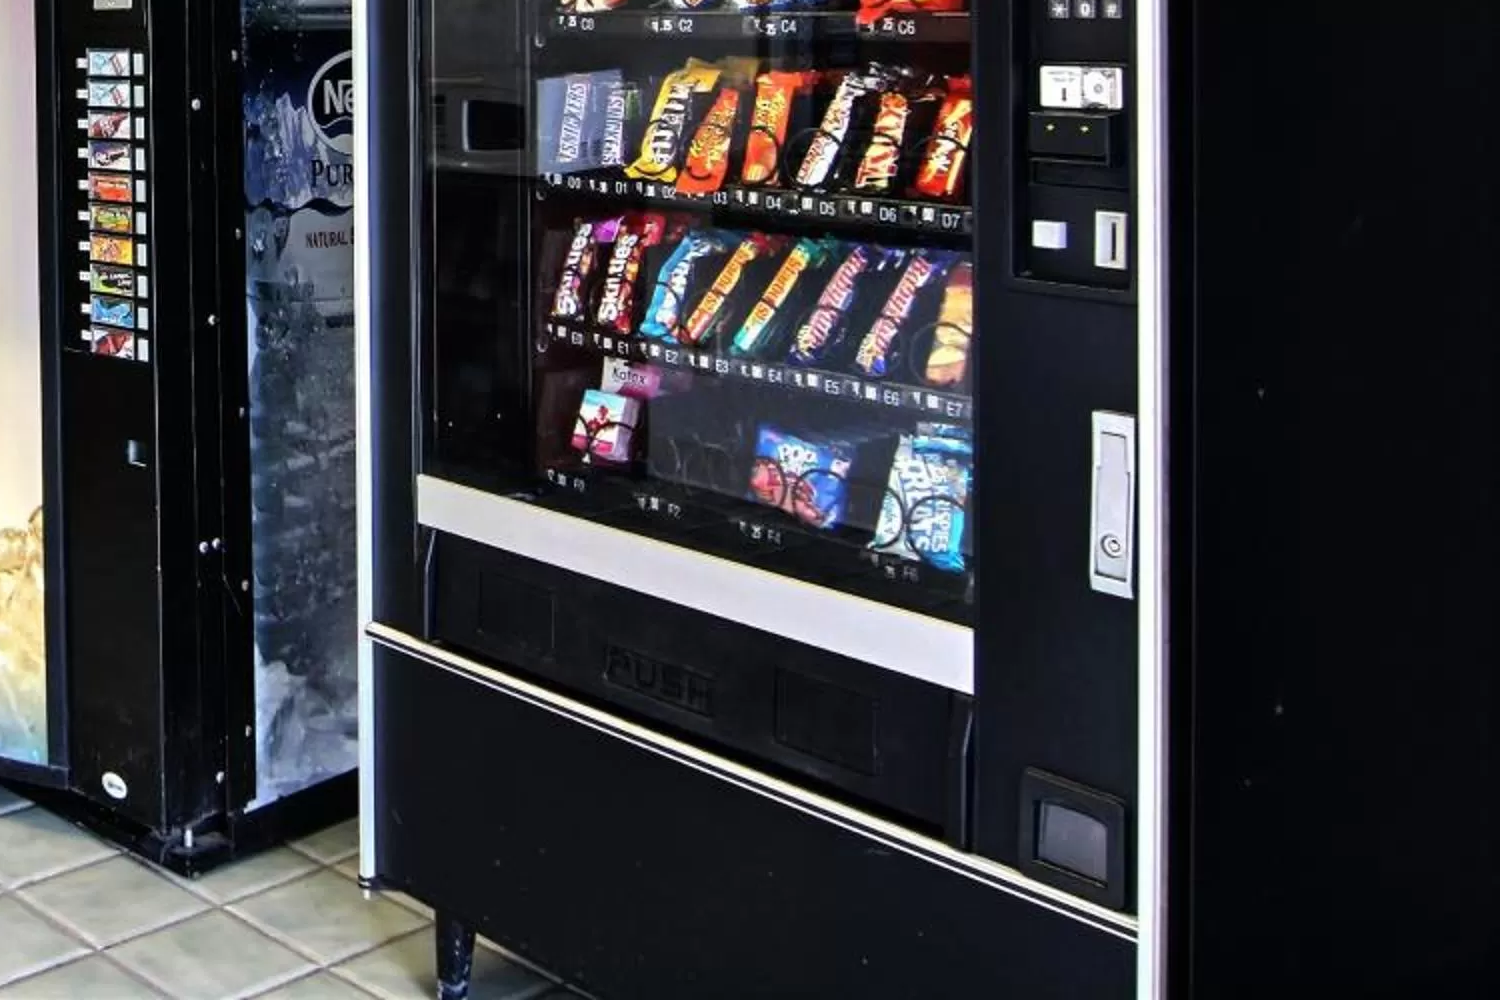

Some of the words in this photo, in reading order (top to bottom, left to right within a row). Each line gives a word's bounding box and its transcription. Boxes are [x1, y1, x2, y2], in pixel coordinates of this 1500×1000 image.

[678, 19, 693, 32] C2
[781, 19, 797, 33] C4
[898, 20, 915, 35] C6
[311, 159, 354, 187] PUR
[766, 196, 781, 209] D4
[819, 201, 836, 216] D5
[879, 207, 896, 222] D6
[942, 213, 960, 228] D7
[306, 231, 348, 248] NATURAL
[617, 342, 629, 354] E1
[665, 350, 679, 363] E2
[767, 369, 782, 384] E4
[824, 379, 840, 395] E5
[883, 389, 900, 406] E6
[946, 401, 963, 418] E7
